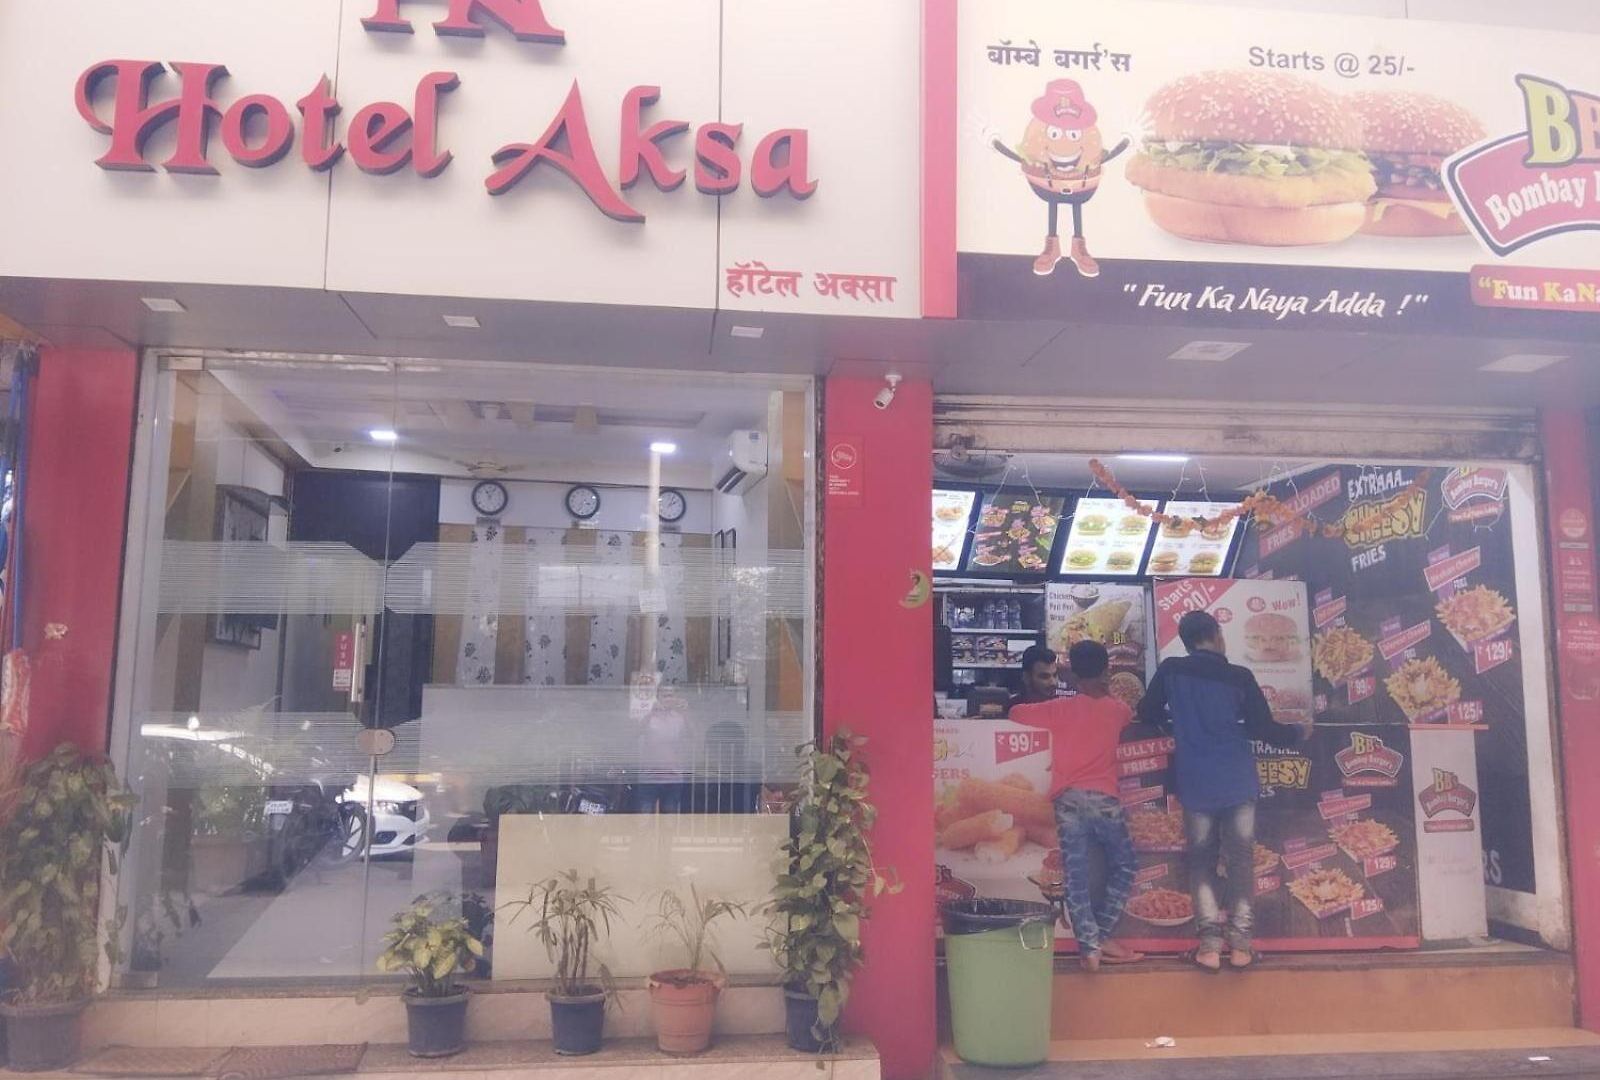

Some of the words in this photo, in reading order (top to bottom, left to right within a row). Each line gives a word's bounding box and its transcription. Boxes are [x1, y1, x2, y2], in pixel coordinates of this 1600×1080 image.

[986, 39, 1041, 67] बॉम्बे
[1248, 45, 1325, 72] Starts
[1333, 52, 1361, 79] @
[1367, 54, 1415, 77] 25/-
[74, 58, 460, 179] Hotel
[484, 78, 819, 223] Aksa
[1484, 171, 1587, 231] Bombay
[724, 259, 803, 298] हॉटेल
[814, 271, 898, 303] अक्सा
[1196, 285, 1235, 312] Ka
[1240, 286, 1308, 321] Naya
[1311, 289, 1386, 317] Adda
[1295, 476, 1341, 512] LOADED
[1266, 525, 1295, 552] FRIES
[1351, 545, 1387, 573] FRIES
[1158, 580, 1193, 610] Starts
[1009, 733, 1041, 754] 99/-
[1122, 757, 1158, 775] FRIES
